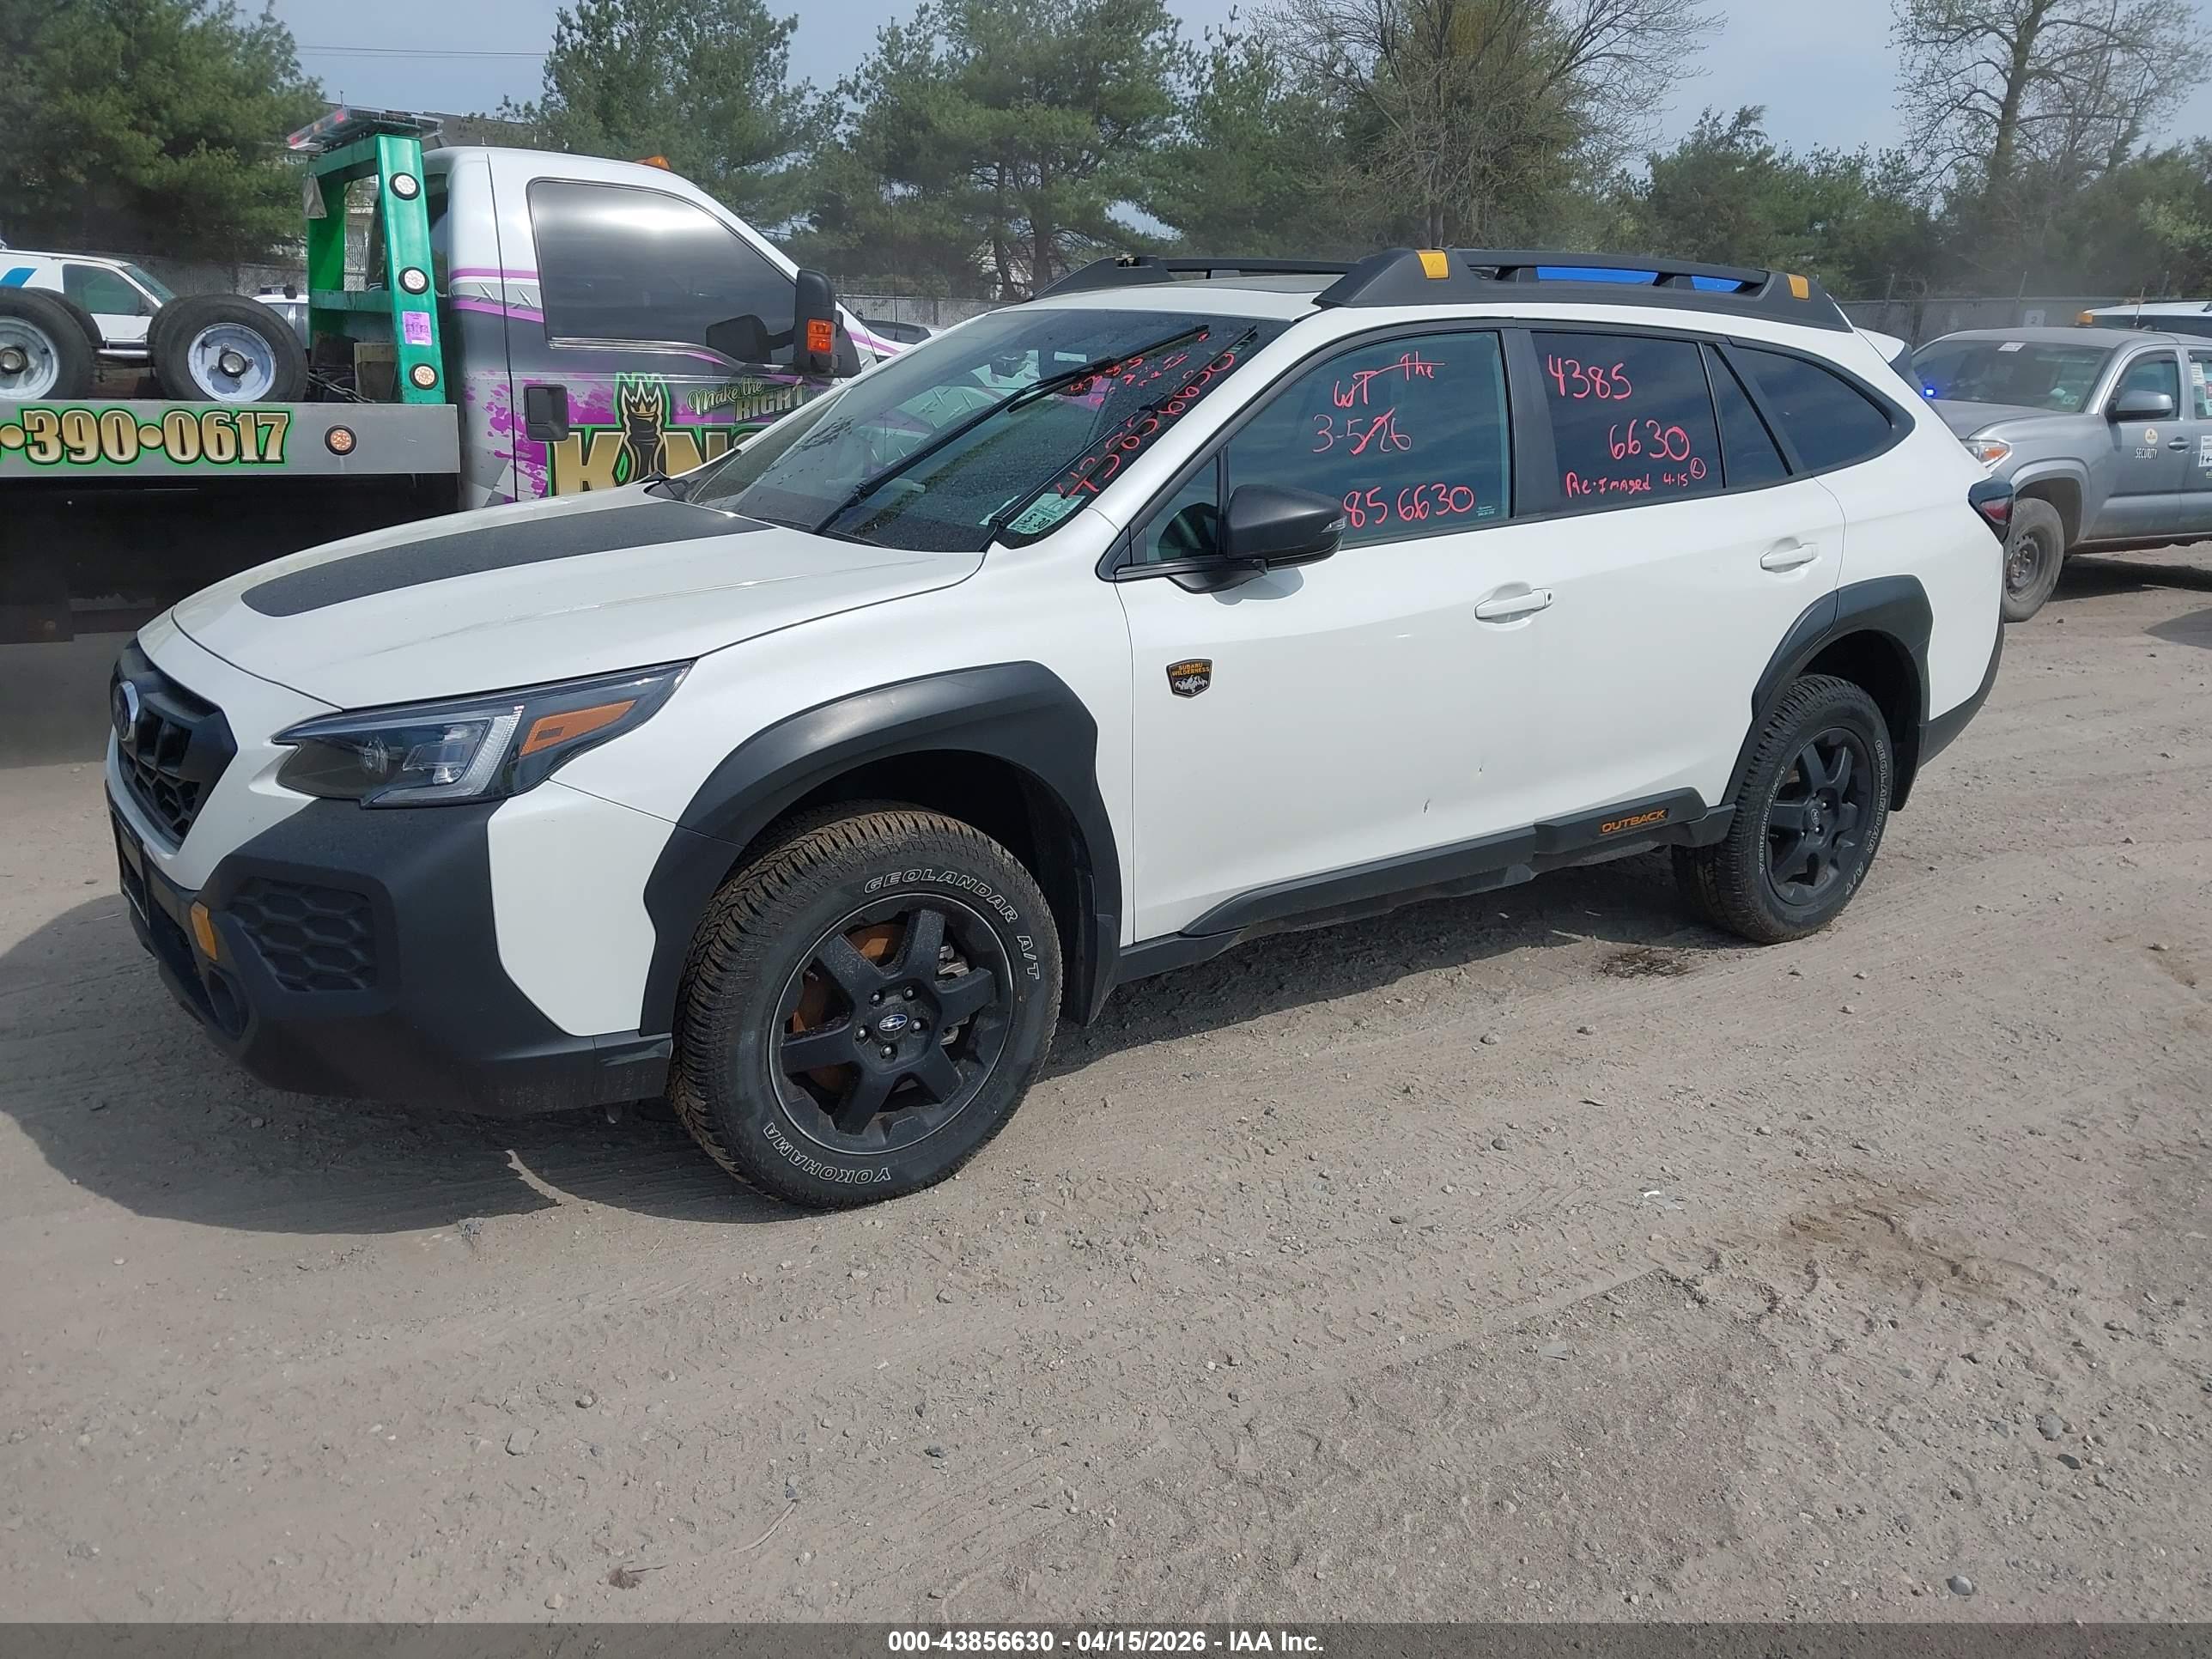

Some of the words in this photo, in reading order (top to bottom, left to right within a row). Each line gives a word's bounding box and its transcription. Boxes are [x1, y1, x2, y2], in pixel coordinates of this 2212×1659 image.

[688, 385, 738, 416] Make
[741, 372, 763, 397] the
[1548, 354, 1632, 400] 4385
[735, 384, 805, 422] RIGHT
[1608, 418, 1691, 461] 6630
[2136, 447, 2158, 460] SECURITY
[1171, 666, 1210, 676] WILDERNESS
[1601, 809, 1666, 834] OUTBACK
[864, 868, 1019, 923] GEOLANDAR
[1017, 935, 1041, 981] A/T
[763, 1121, 892, 1185] YOKOHAMA
